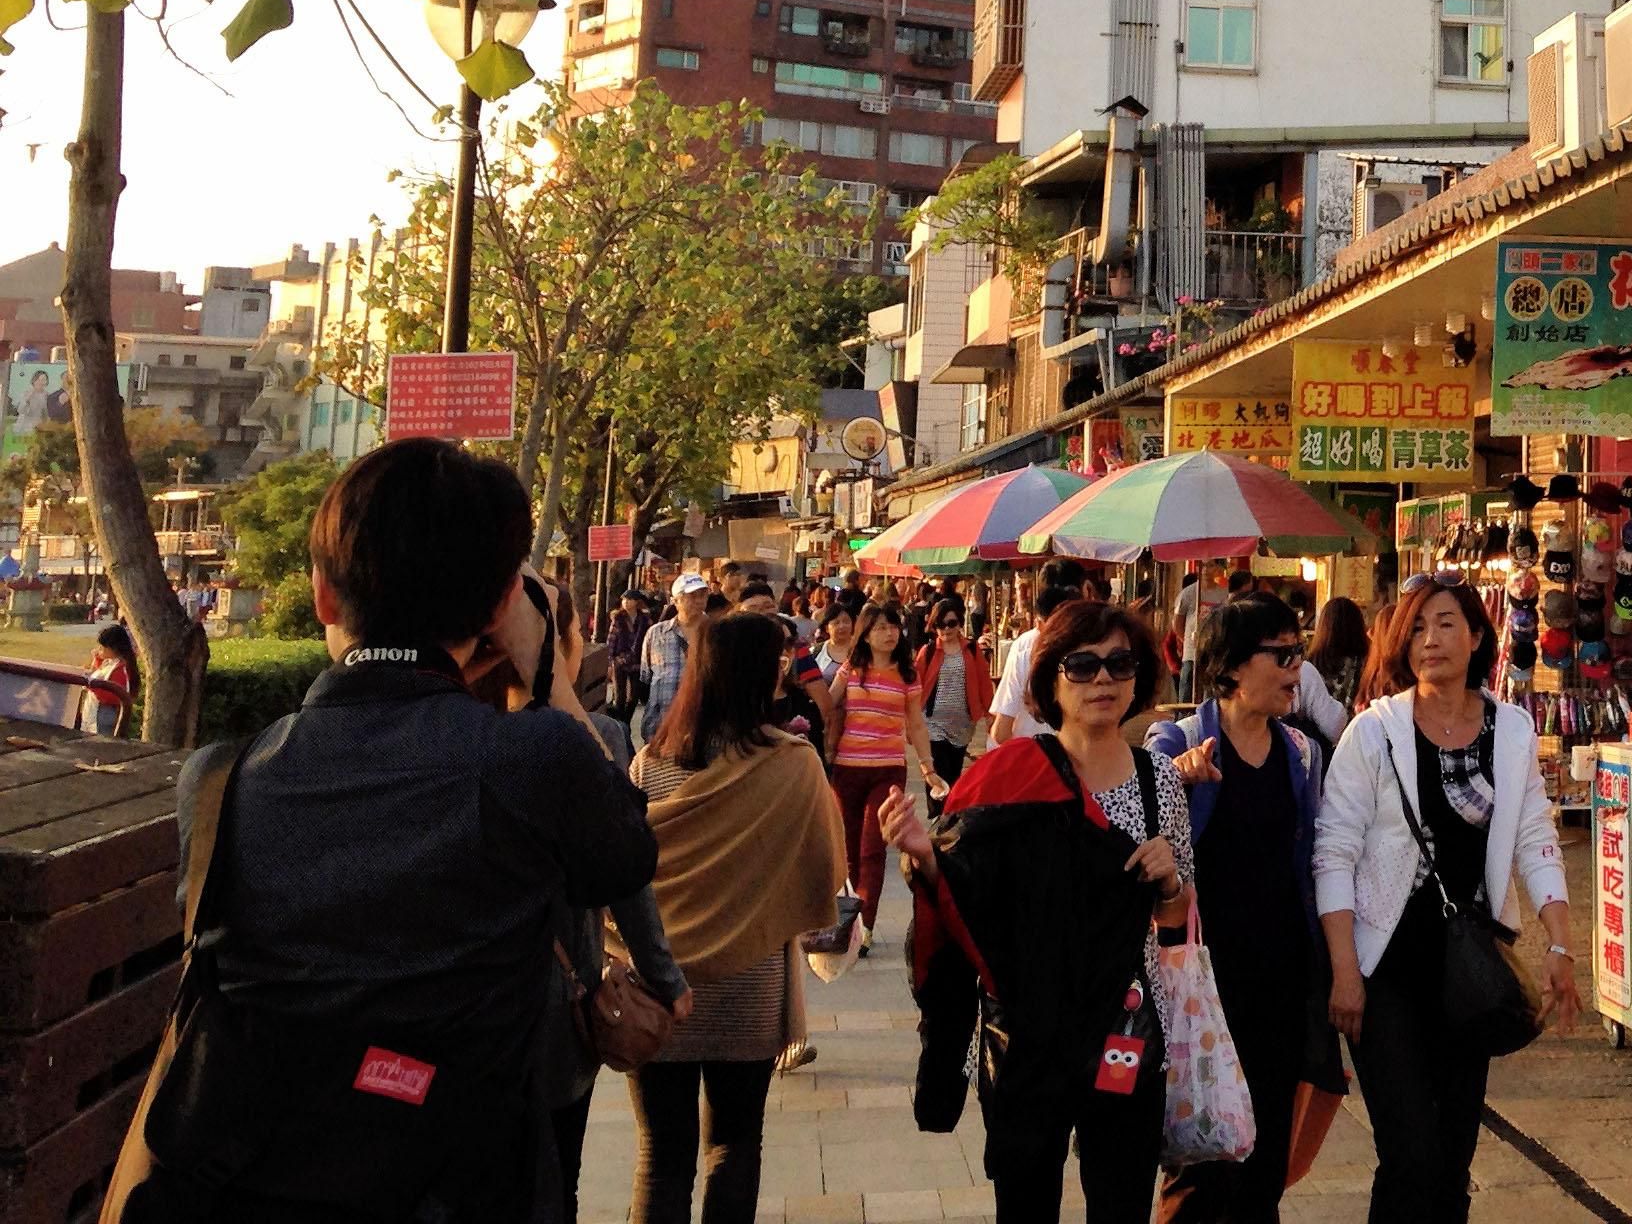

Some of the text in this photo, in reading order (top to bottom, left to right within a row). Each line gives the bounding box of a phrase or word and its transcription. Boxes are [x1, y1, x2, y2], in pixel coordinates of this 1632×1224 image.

[1509, 280, 1588, 316] 總店
[1505, 324, 1590, 343] 創始店
[1177, 427, 1293, 450] 北港地瓜
[1391, 428, 1473, 471] 青草茶
[344, 647, 418, 667] Canon
